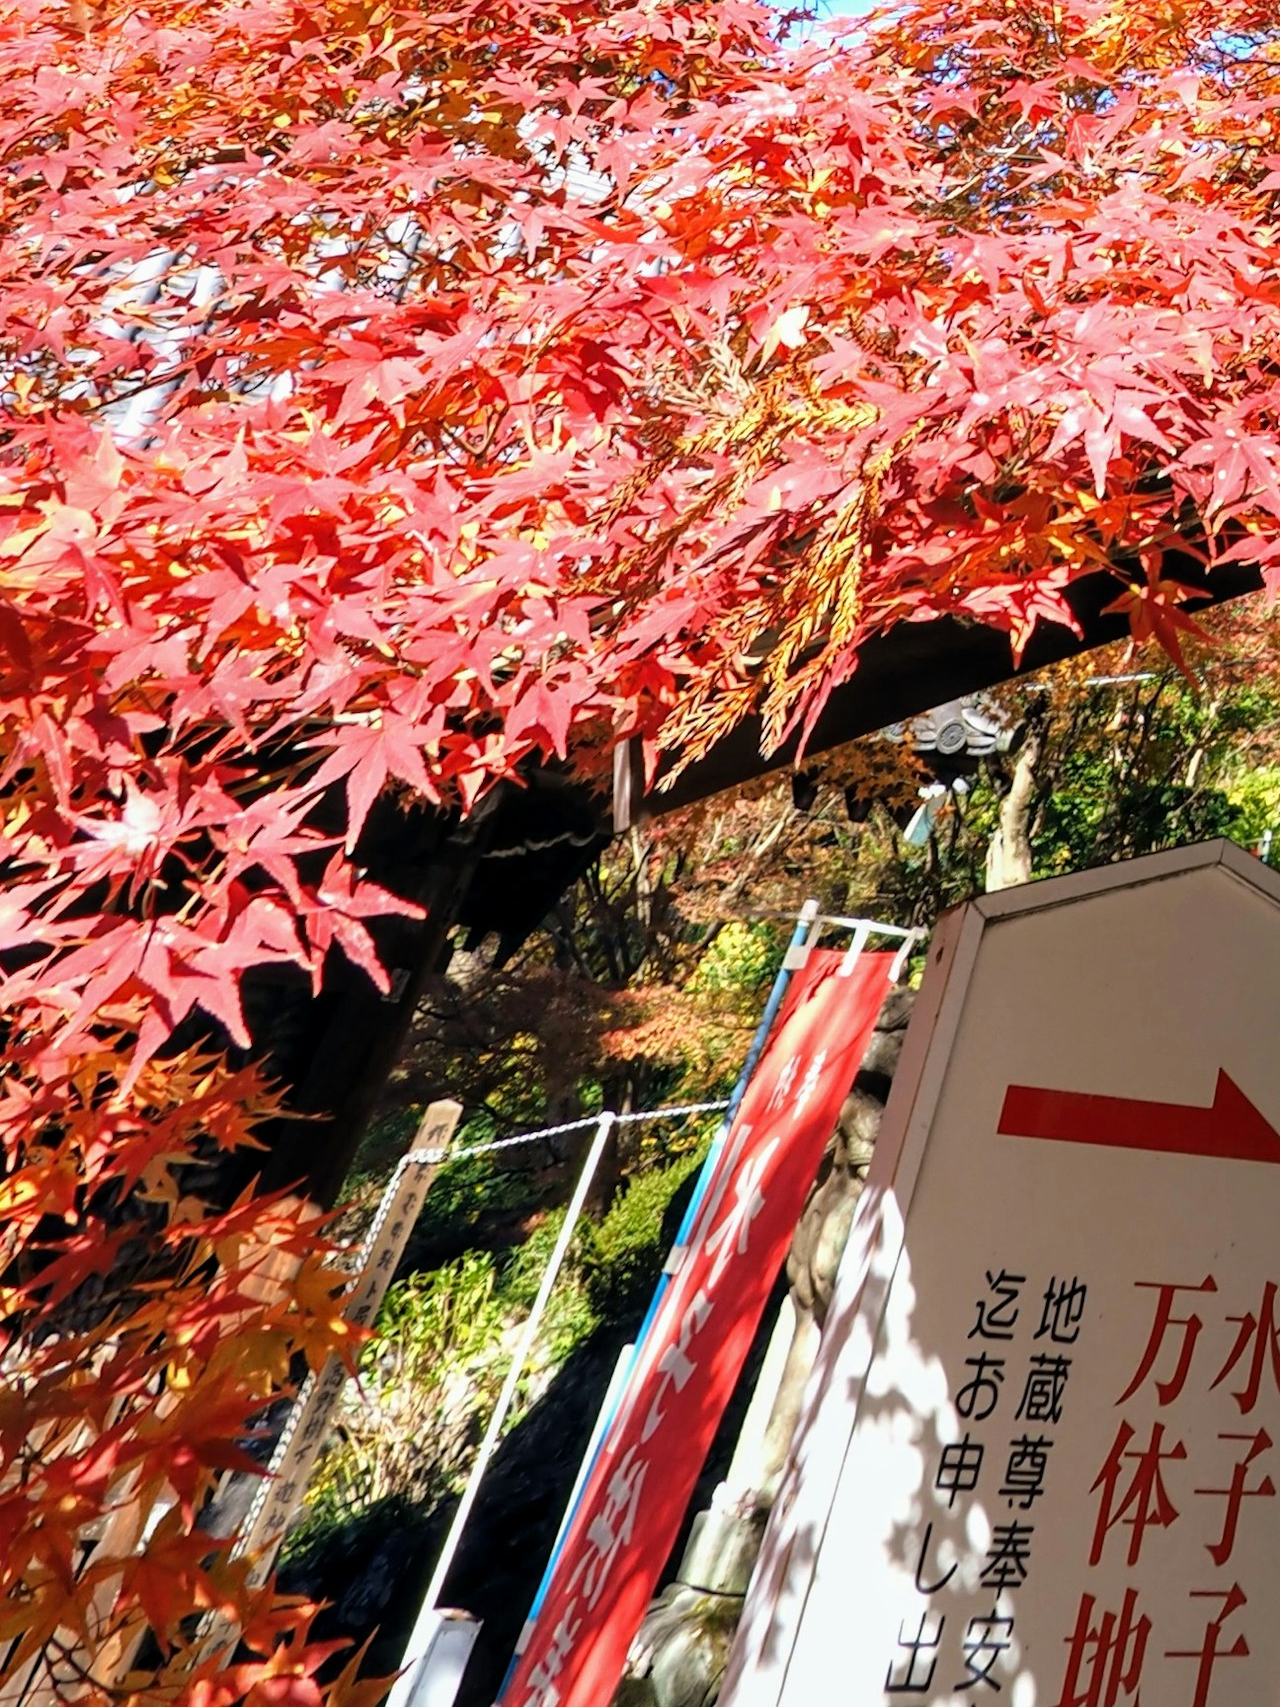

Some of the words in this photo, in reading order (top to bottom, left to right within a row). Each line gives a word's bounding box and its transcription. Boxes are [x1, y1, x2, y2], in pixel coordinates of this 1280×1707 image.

[953, 1275, 1087, 1692] 地蔵尊奉安
